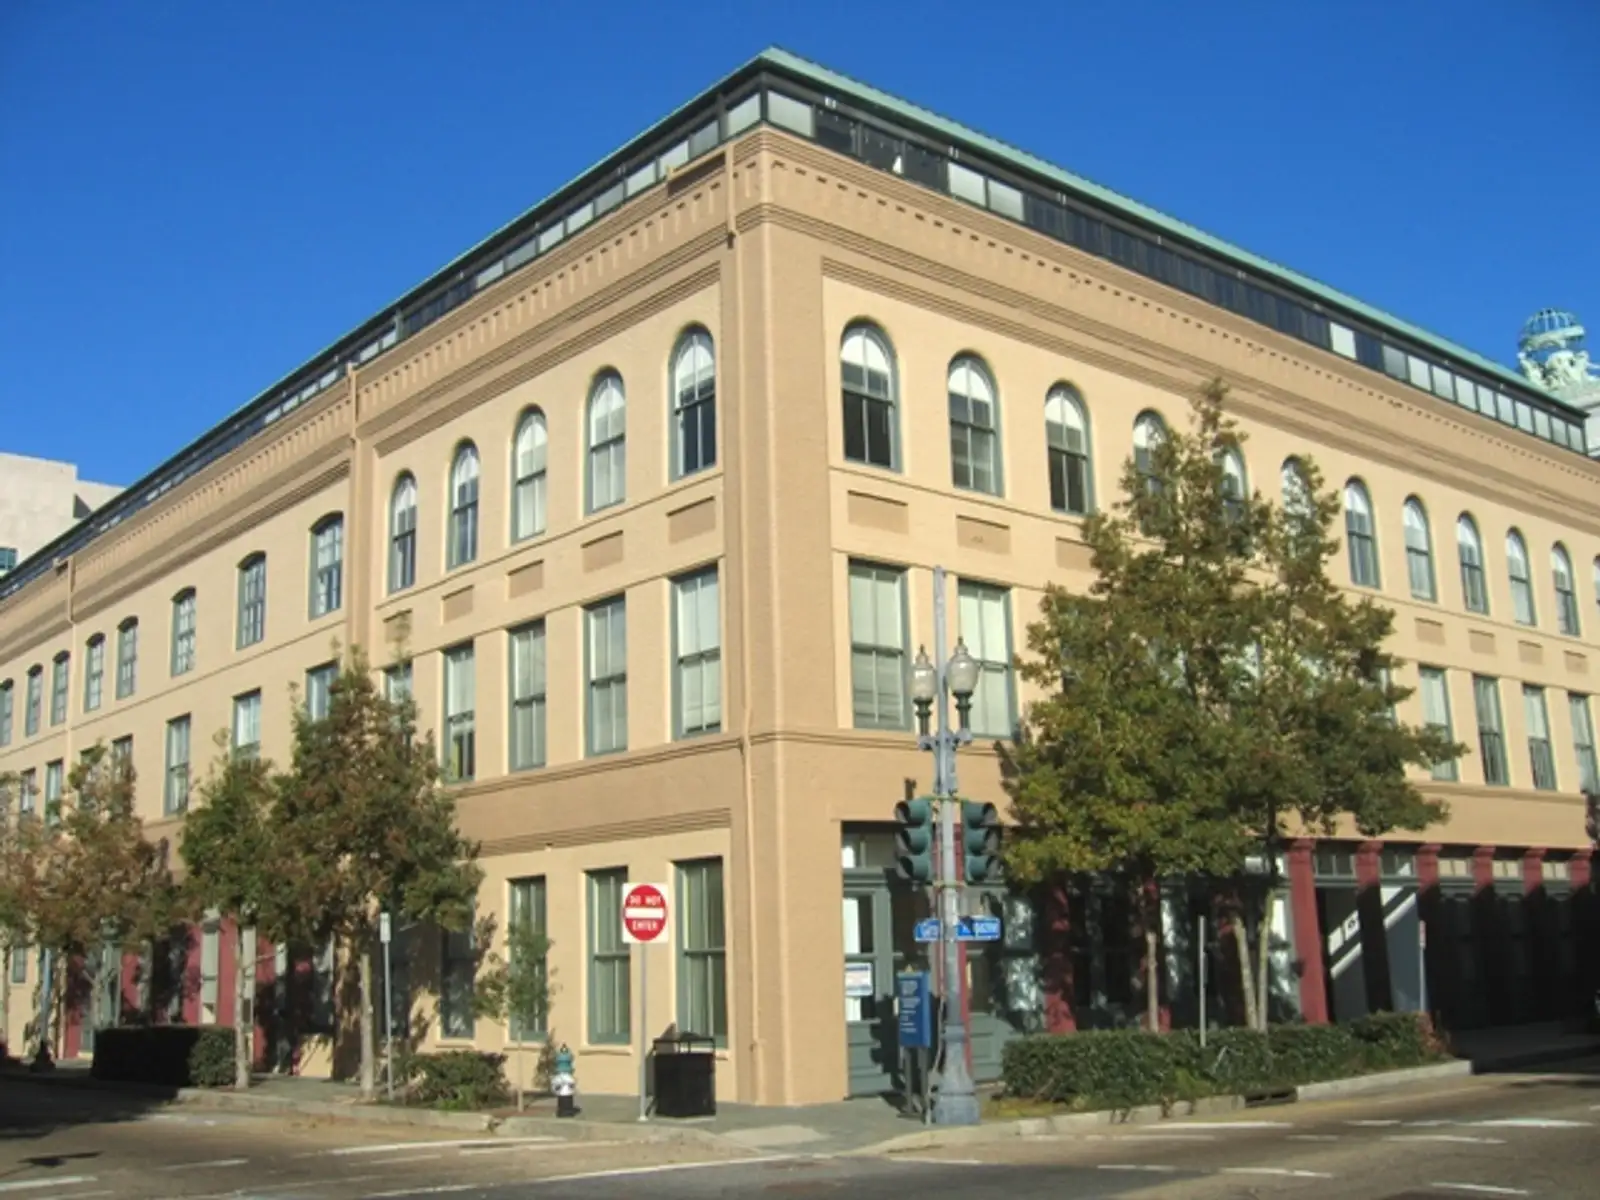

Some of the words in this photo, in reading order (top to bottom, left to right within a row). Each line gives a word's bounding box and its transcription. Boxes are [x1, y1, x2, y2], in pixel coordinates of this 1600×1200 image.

[630, 895, 641, 905] DO
[645, 895, 661, 905] NOT
[632, 920, 658, 931] ENTER
